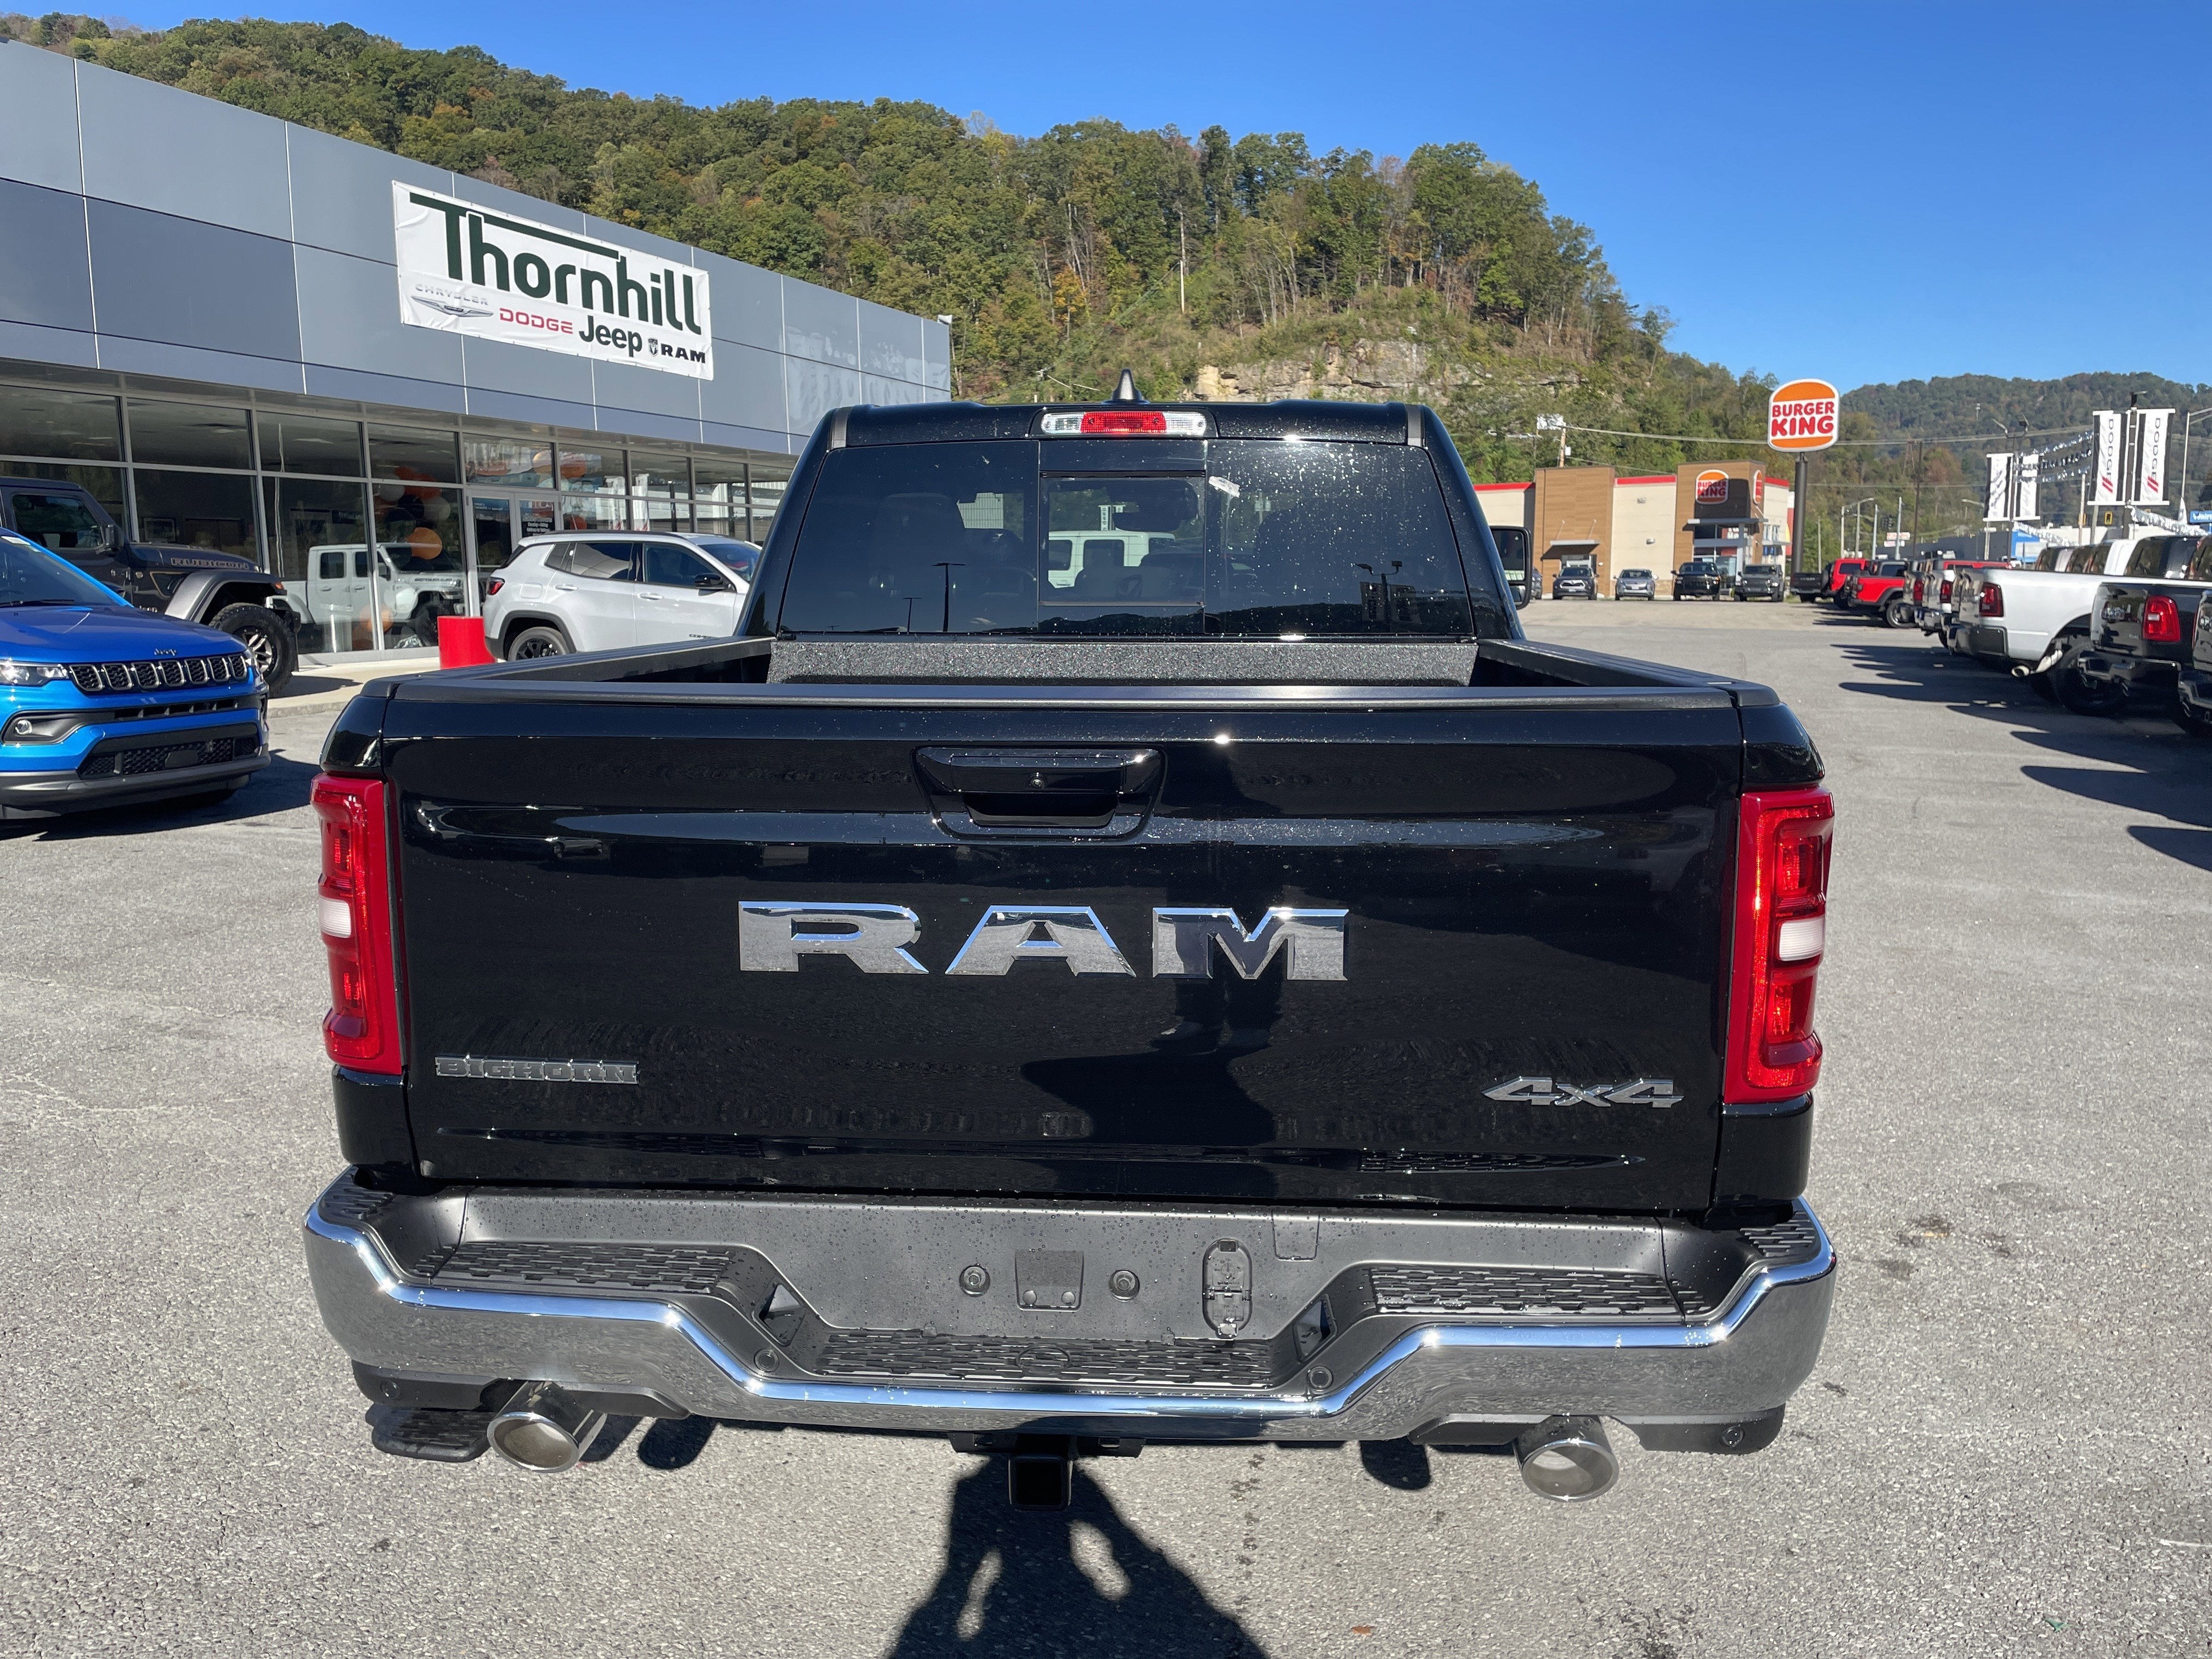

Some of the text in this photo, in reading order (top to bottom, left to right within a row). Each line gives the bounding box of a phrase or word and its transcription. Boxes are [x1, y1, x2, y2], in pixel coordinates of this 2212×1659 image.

[410, 192, 701, 335] Thornhill
[415, 284, 706, 363] CHRYSLER DODGE Jeep RAM
[1771, 415, 1834, 437] KING
[1772, 402, 1835, 417] BURGER
[2152, 417, 2160, 482] DODGE
[1697, 488, 1726, 496] KING
[737, 900, 1350, 981] RAM
